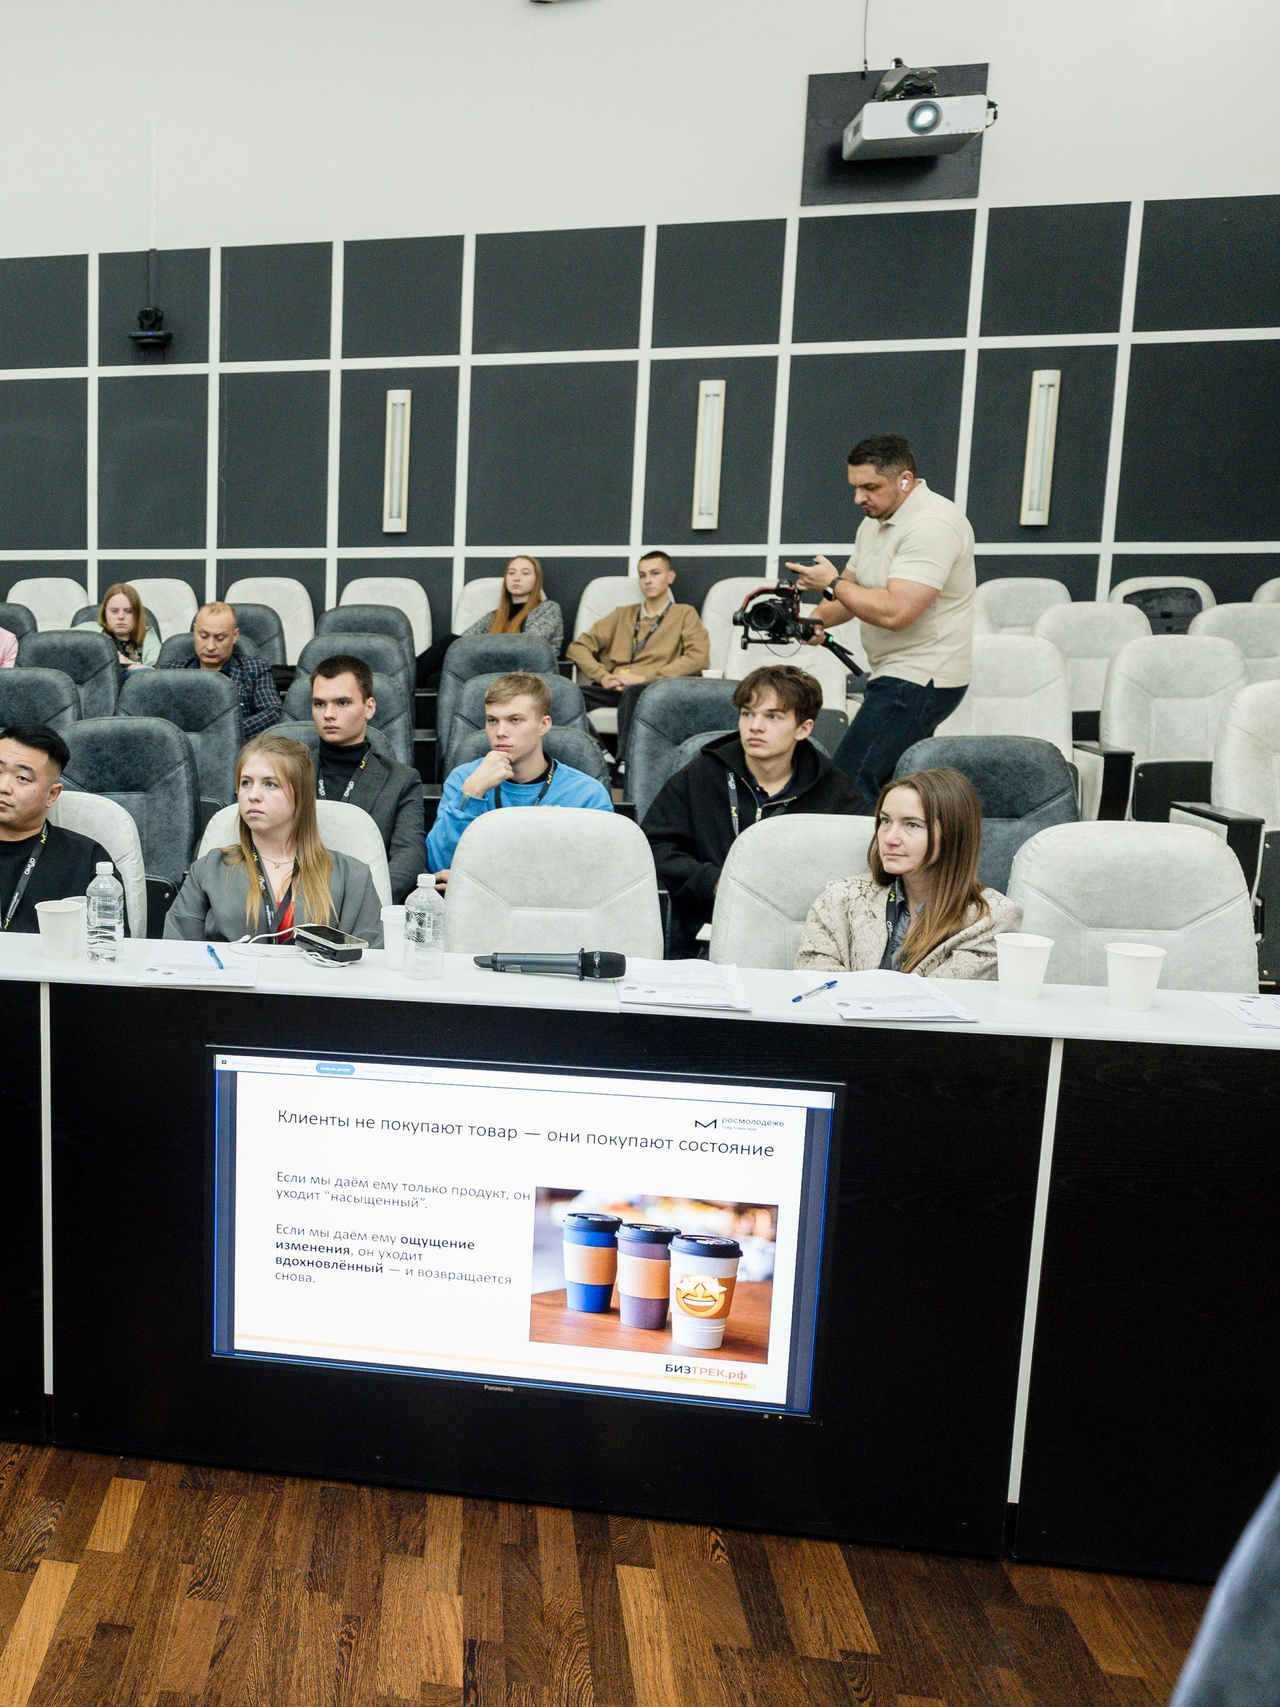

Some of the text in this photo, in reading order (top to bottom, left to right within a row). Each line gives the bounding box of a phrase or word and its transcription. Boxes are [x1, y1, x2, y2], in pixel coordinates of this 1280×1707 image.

[721, 1117, 785, 1127] росмолодёжь
[278, 1109, 350, 1128] Клиенты
[355, 1117, 375, 1129] не
[381, 1119, 463, 1135] покупают
[468, 1124, 518, 1140] товар
[547, 1129, 580, 1144] они
[586, 1132, 674, 1150] покупают
[679, 1139, 775, 1158] состояние
[275, 1189, 321, 1202] уходит
[277, 1171, 531, 1201] Если мы даём ему только продукт, он
[275, 1223, 475, 1250] Если мы даём ему ощущение
[275, 1241, 424, 1262] изменения, он уходит
[275, 1256, 384, 1274] вдохновлённый
[405, 1267, 414, 1277] и
[417, 1268, 513, 1286] возвращается
[275, 1271, 316, 1284] снова.
[665, 1363, 747, 1381] БИЗТРЕК.рф
